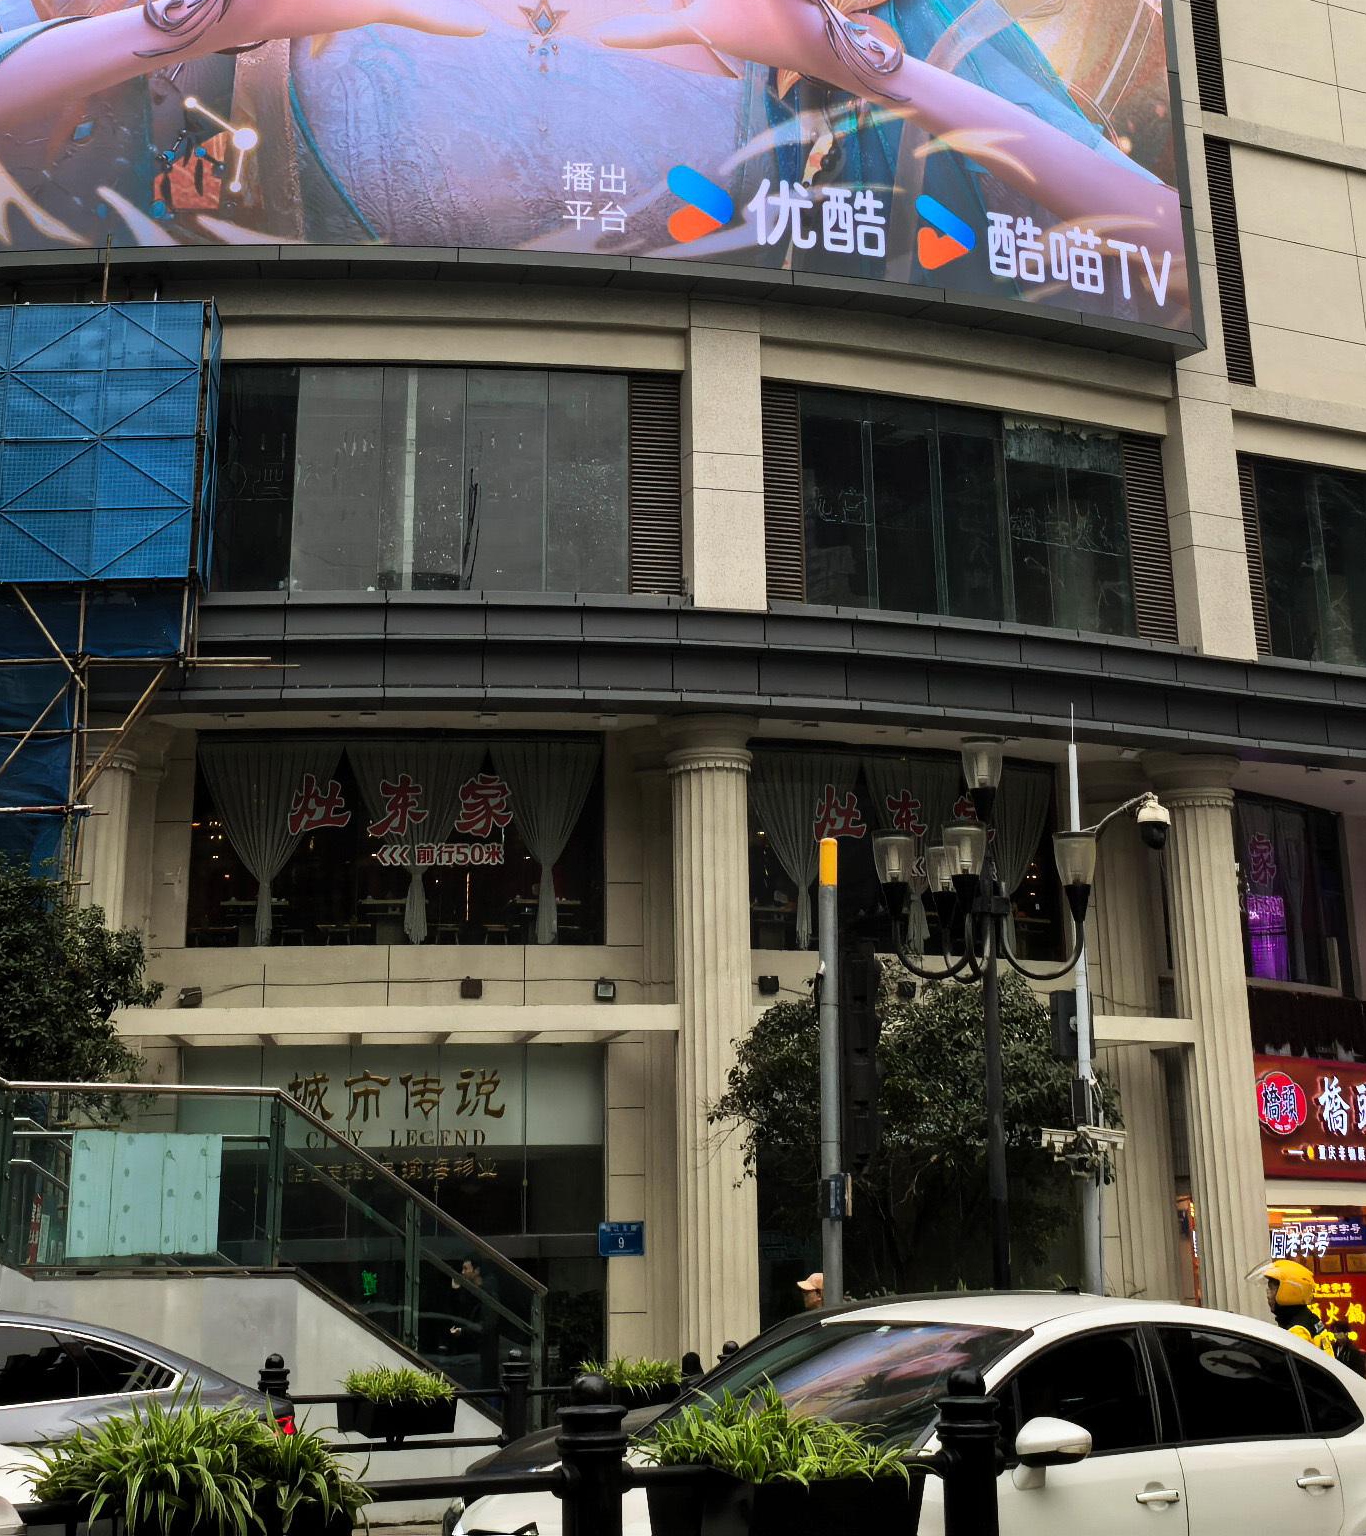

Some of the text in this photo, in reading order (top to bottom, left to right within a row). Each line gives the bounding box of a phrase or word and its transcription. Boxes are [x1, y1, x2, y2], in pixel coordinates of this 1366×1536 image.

[562, 161, 628, 195] 播出
[562, 199, 628, 234] 平台
[747, 178, 888, 259] 优酷
[986, 210, 1173, 308] 酷喵TV
[389, 1128, 486, 1147] LEGEND
[618, 1236, 625, 1249] 9
